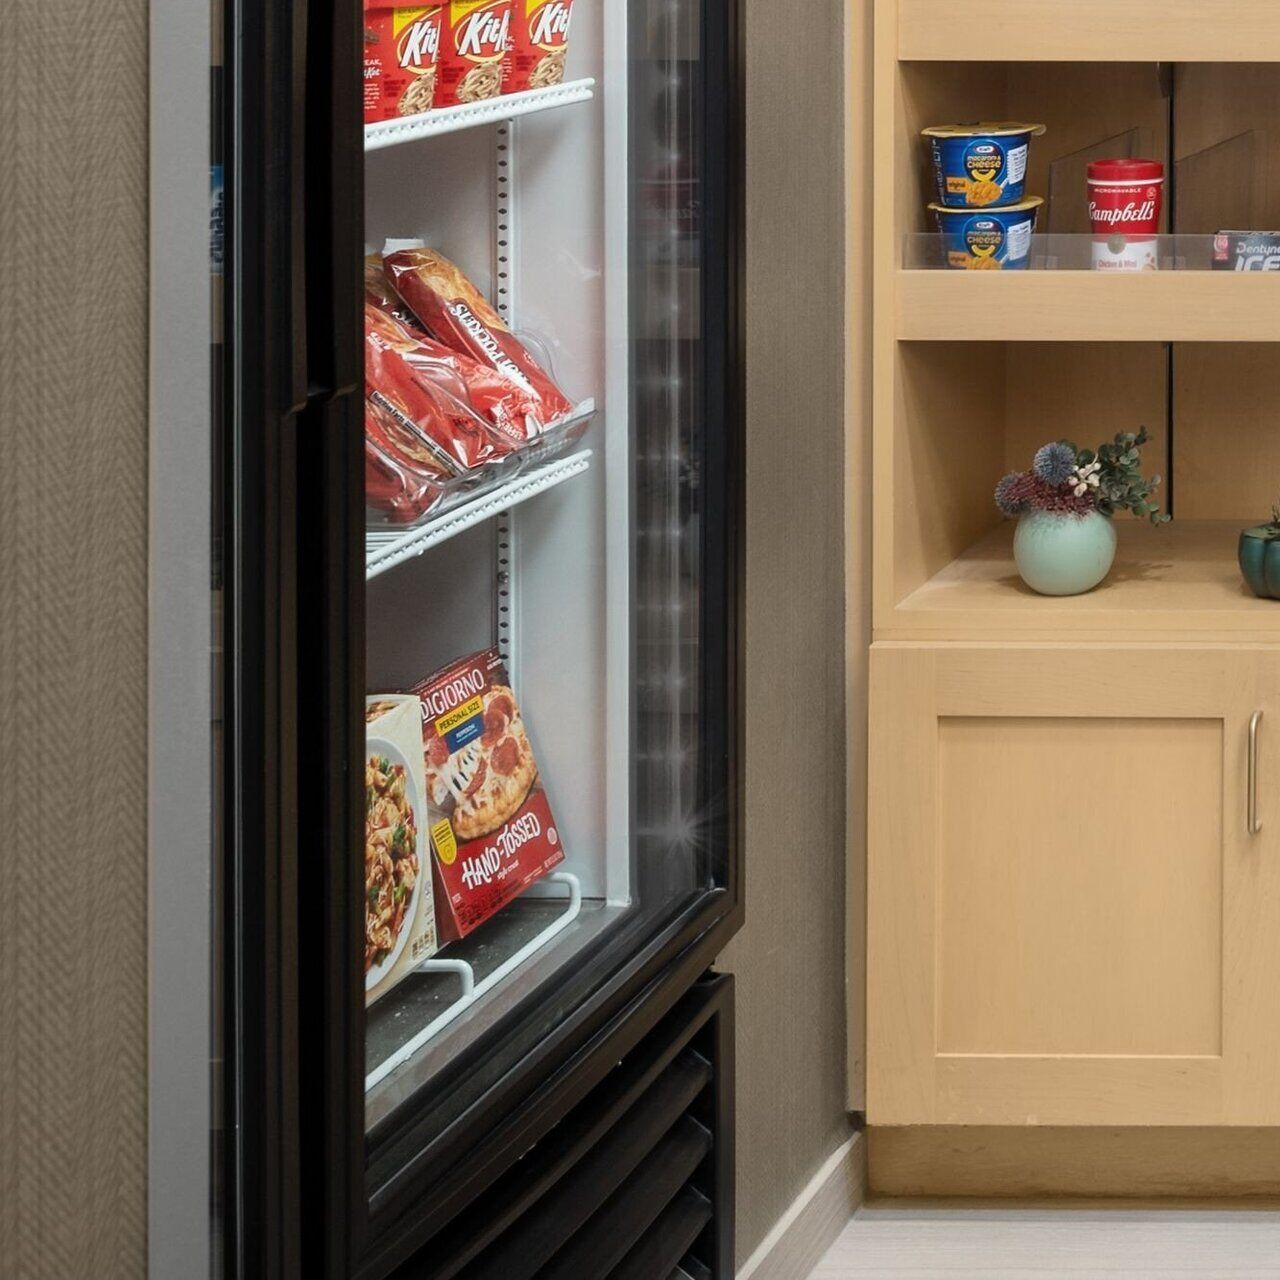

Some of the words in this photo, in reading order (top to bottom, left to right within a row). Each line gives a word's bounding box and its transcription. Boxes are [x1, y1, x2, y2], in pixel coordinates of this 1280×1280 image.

[1089, 201, 1154, 225] Campbell's
[450, 302, 502, 364] POCKETS
[497, 356, 529, 388] HOT
[439, 709, 469, 731] PERSONAL
[468, 700, 481, 714] SIZE
[462, 812, 541, 890] HAND-TOSSED
